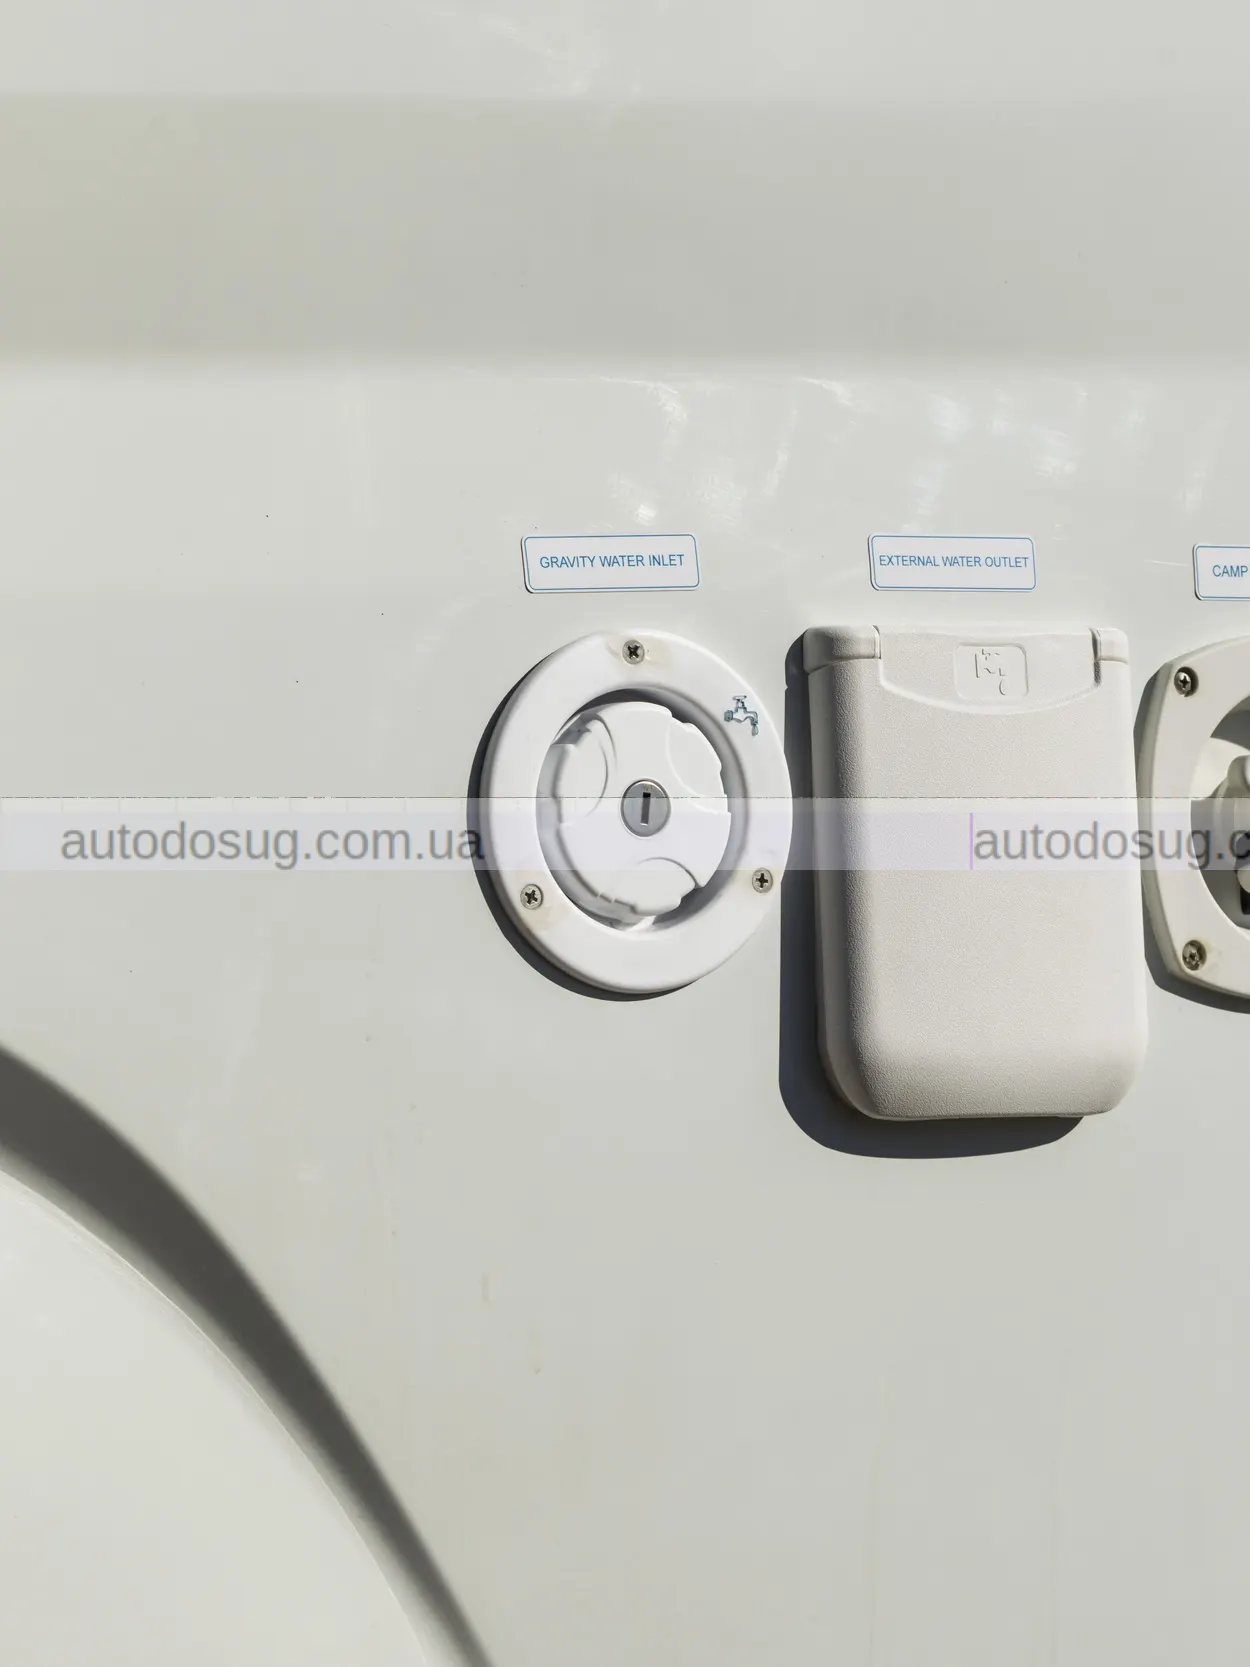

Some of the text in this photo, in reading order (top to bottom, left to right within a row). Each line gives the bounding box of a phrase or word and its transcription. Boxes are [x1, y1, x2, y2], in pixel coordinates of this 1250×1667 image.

[539, 553, 685, 569] GRAVITY WATER INLET
[878, 555, 1029, 569] EXTERNAL WATER OUTLET
[1212, 564, 1248, 578] CAMP
